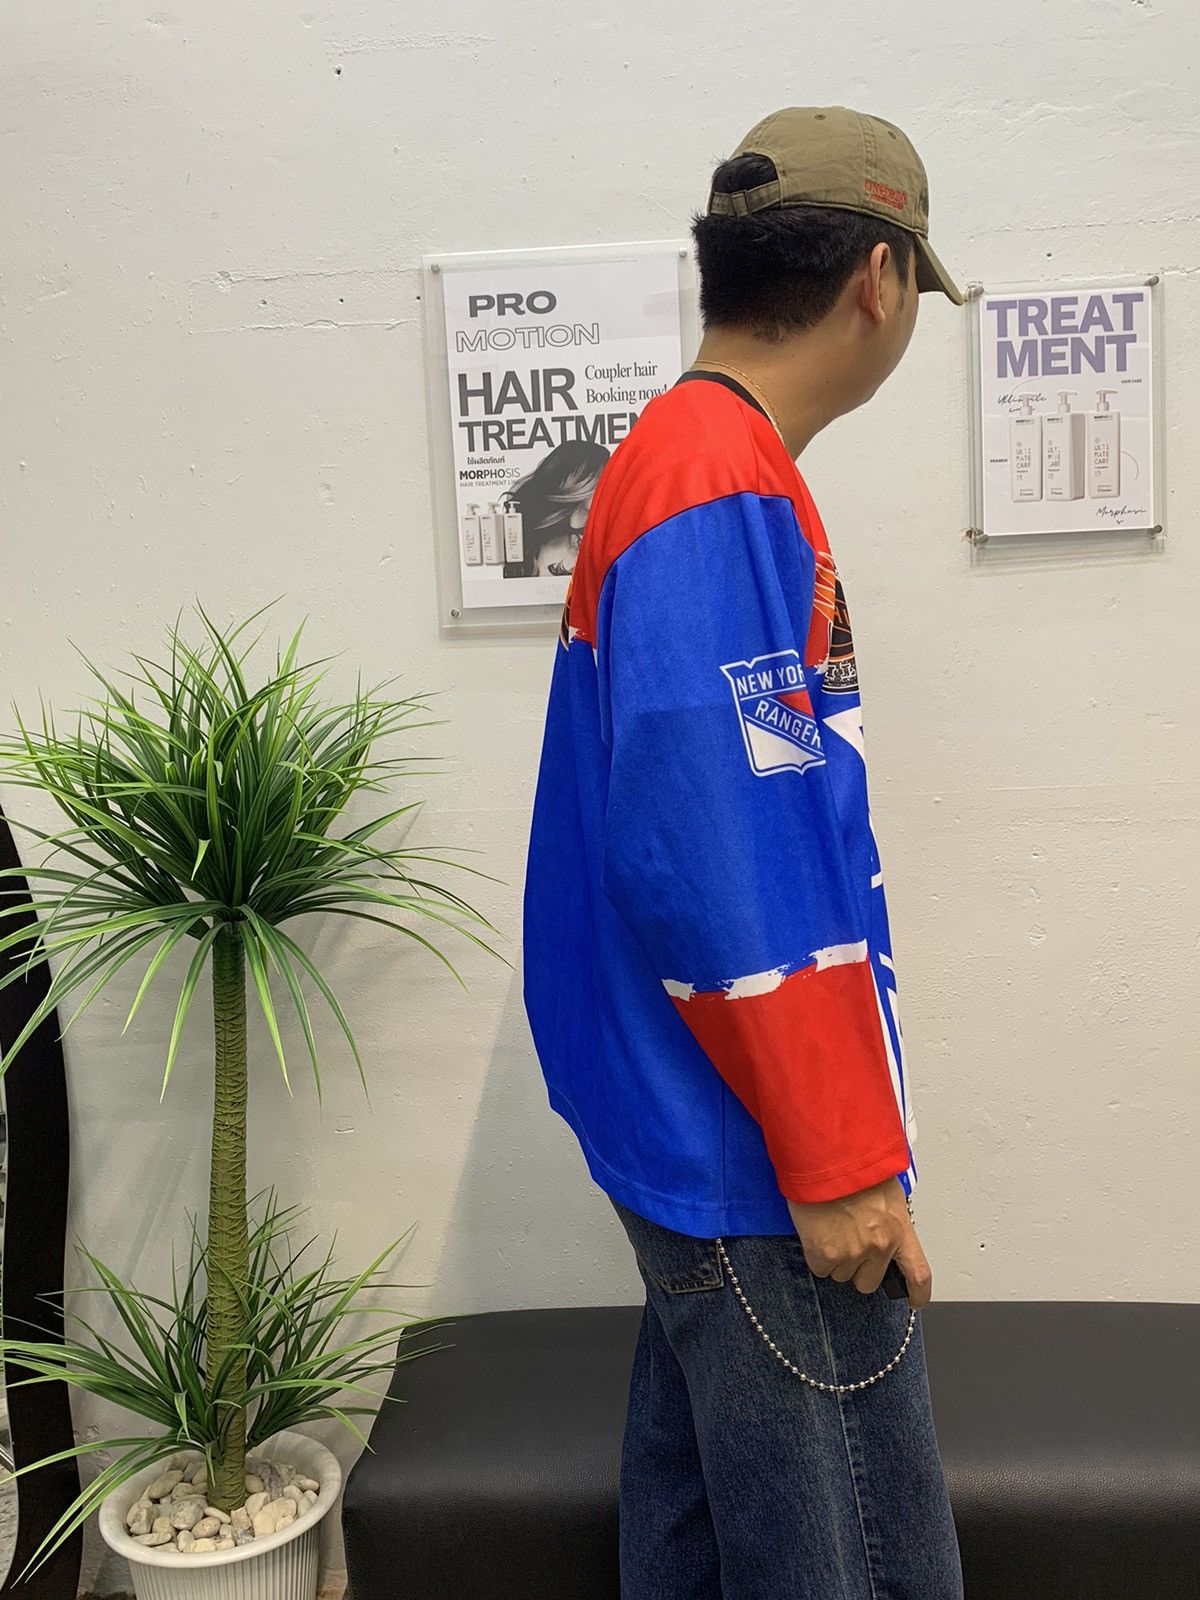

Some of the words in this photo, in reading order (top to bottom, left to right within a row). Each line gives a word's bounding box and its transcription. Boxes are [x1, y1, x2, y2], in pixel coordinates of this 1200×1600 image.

[468, 290, 557, 318] PRO
[986, 292, 1144, 338] TREAT
[455, 323, 600, 353] MOTION
[584, 363, 632, 383] Coupler
[633, 361, 658, 377] hair
[996, 334, 1137, 379] MENT
[457, 368, 579, 417] HAIR
[586, 386, 637, 405] Booking
[459, 467, 521, 480] MORPHOSIS
[736, 669, 773, 696] NEW
[778, 663, 805, 687] YOR
[754, 700, 822, 749] RANGER
